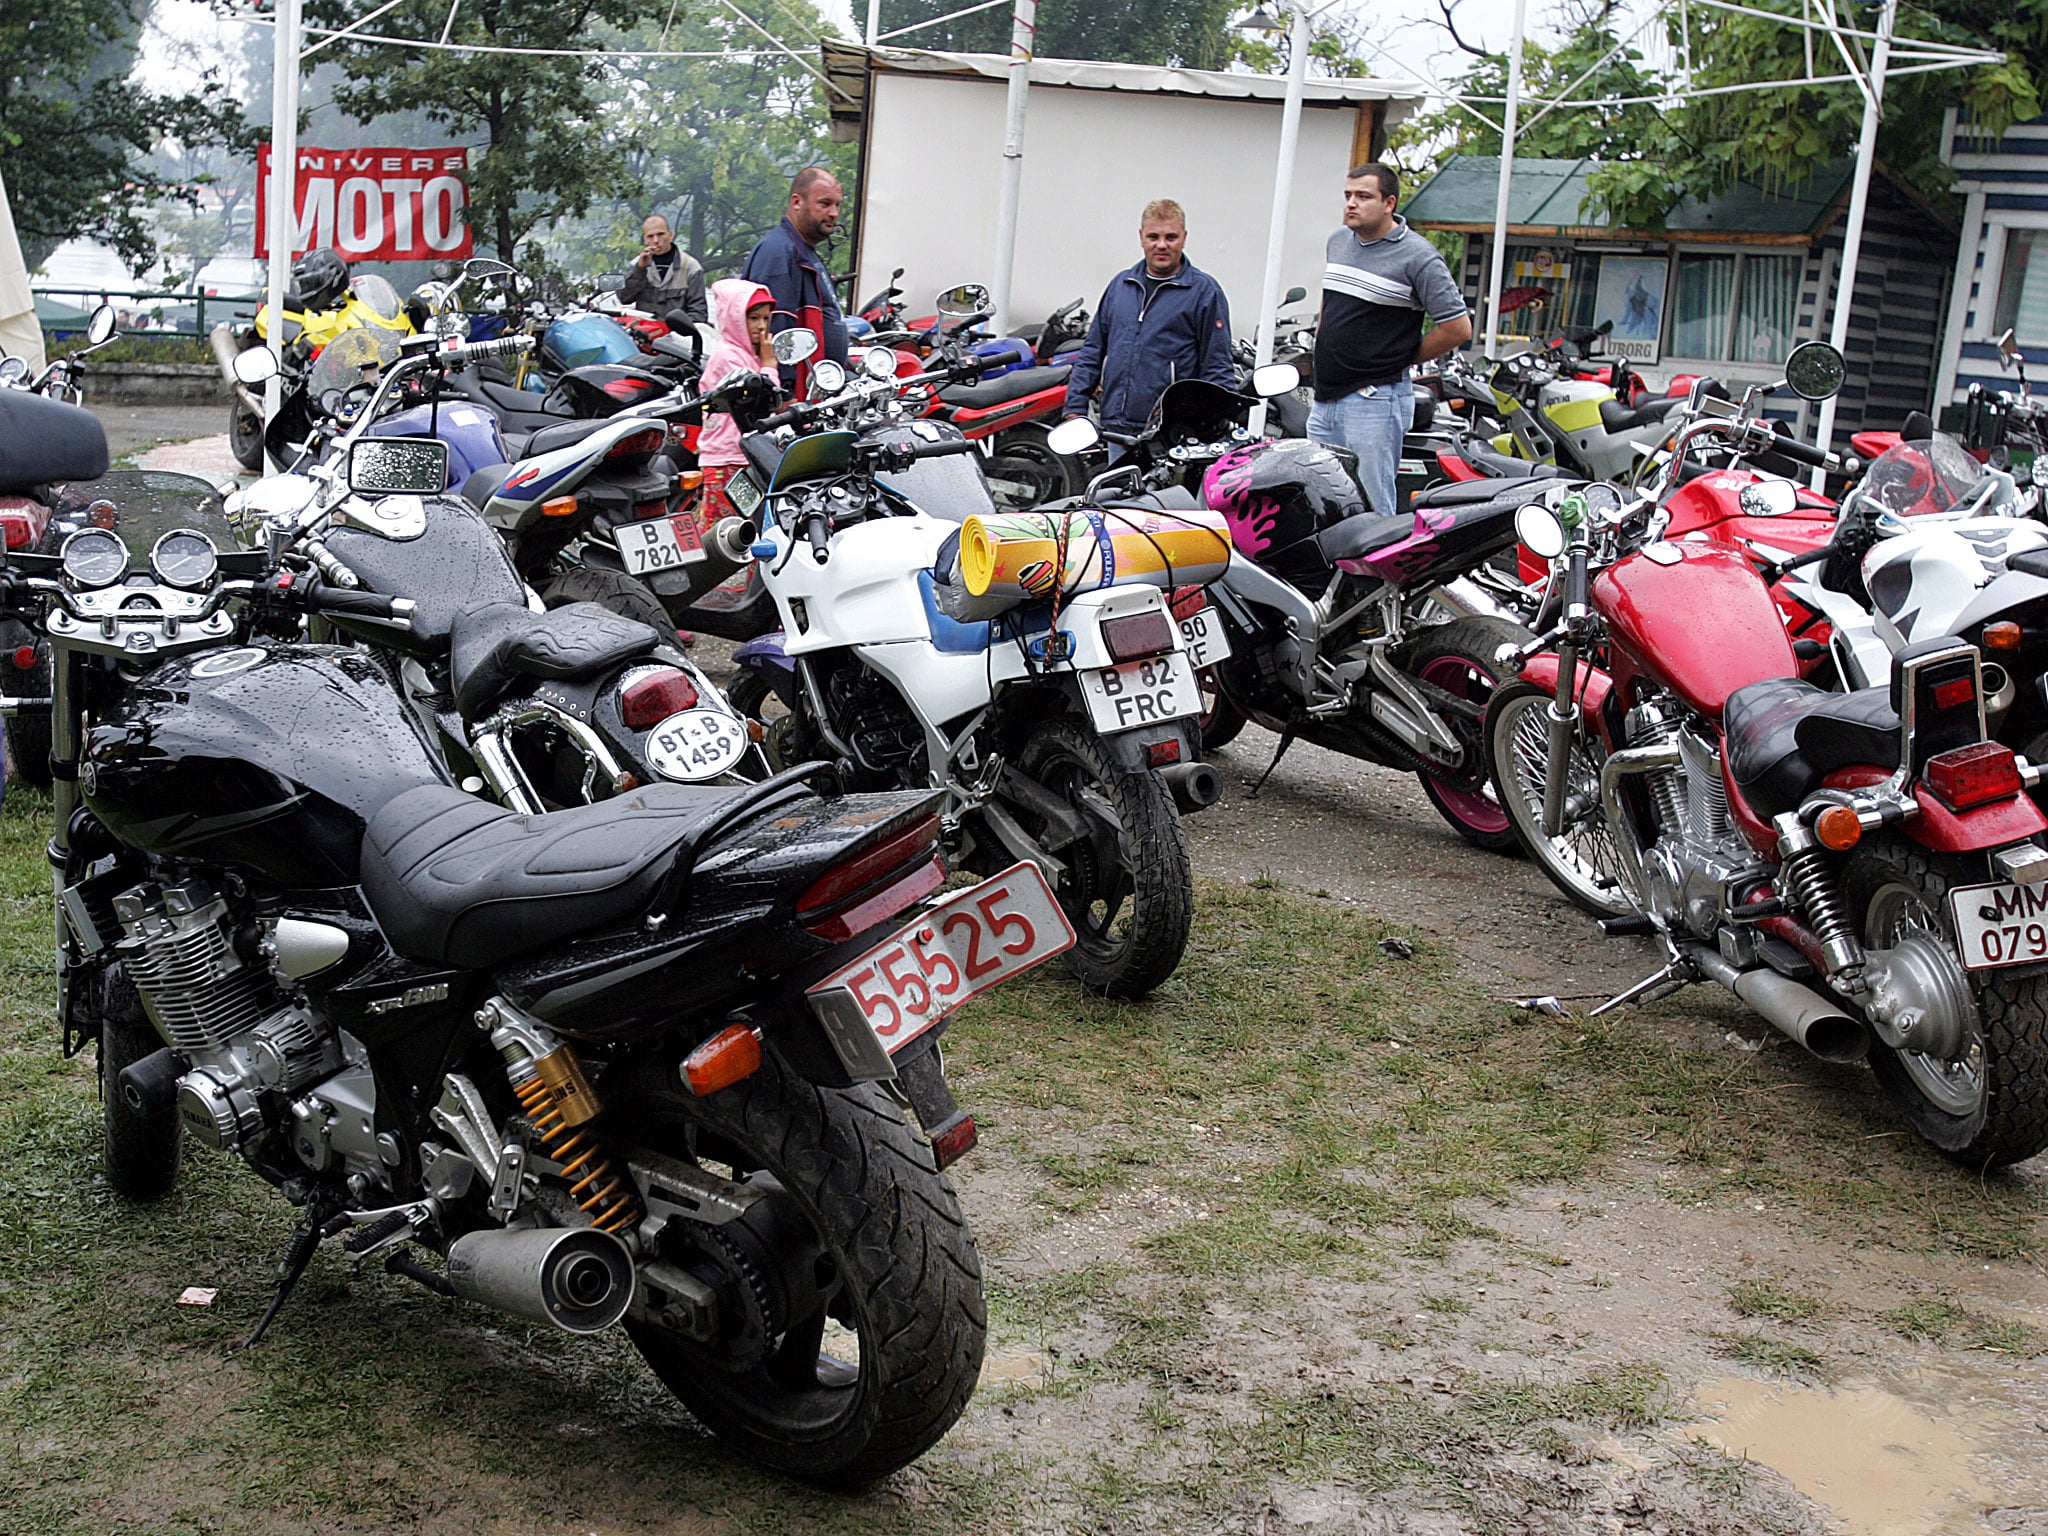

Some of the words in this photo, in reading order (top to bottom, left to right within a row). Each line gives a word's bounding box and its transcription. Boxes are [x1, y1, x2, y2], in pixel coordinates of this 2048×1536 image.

[266, 154, 464, 172] NIVERS
[263, 175, 465, 253] MOTO
[641, 523, 659, 545] B
[634, 542, 682, 571] 7821
[1181, 616, 1207, 642] 90
[1100, 668, 1124, 697] B
[1140, 658, 1175, 688] 82
[1114, 690, 1177, 726] FRC
[657, 726, 689, 754] BT
[700, 716, 720, 735] B
[676, 736, 731, 773] 1459
[1993, 886, 2048, 921] MM
[847, 887, 1036, 1037] 55525
